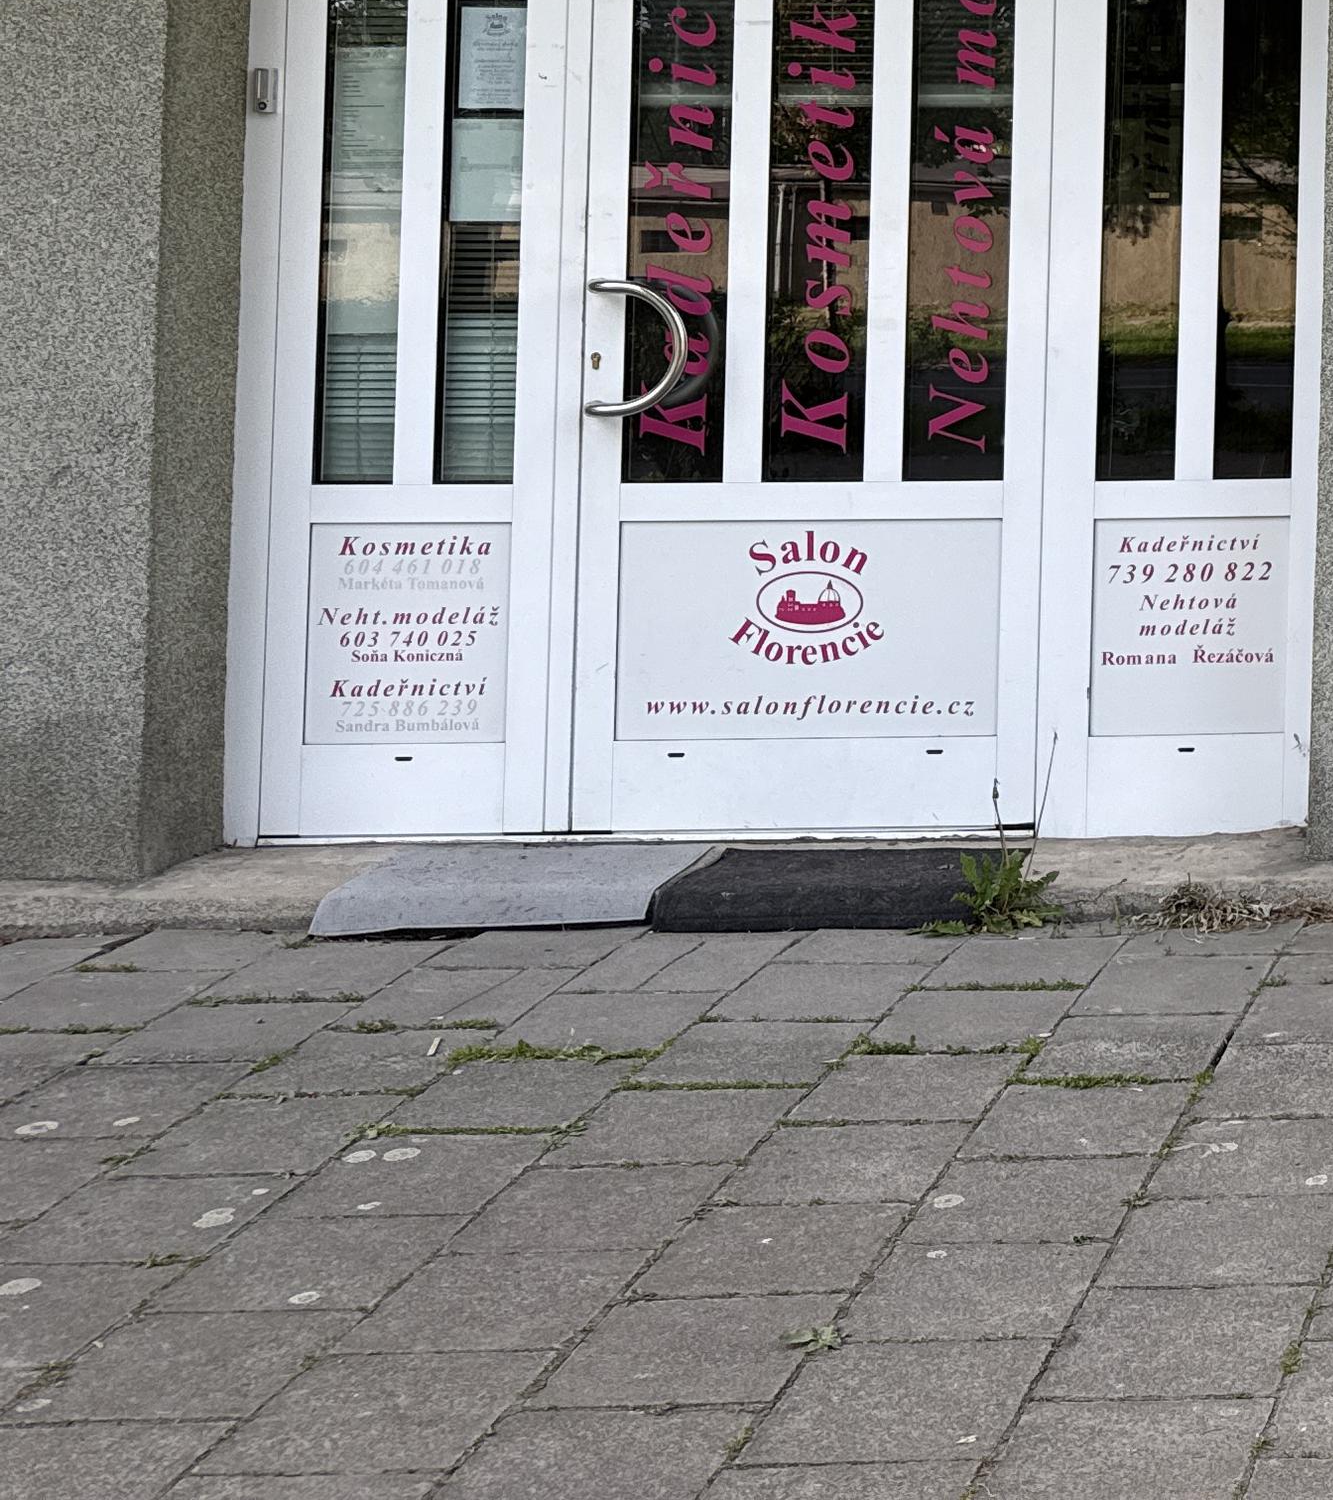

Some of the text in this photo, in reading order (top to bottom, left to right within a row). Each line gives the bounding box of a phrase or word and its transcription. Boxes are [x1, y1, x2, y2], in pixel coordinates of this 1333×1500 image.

[928, 126, 995, 451] Nehtová
[338, 535, 492, 557] Kosmetika
[749, 530, 868, 576] Salon
[1118, 533, 1261, 554] Kadeřnictví
[344, 558, 384, 576] 604
[441, 558, 482, 575] 018
[1107, 560, 1274, 585] 739 280 822
[1138, 592, 1238, 612] Nehtová
[1138, 617, 1238, 637] modeláž
[339, 630, 478, 648] 603 740 025
[728, 617, 885, 665] Florencie
[351, 649, 464, 663] Soňa Koniczná
[1100, 644, 1275, 667] Romana Řezáčová
[329, 676, 488, 698] Kadeřnictví
[437, 699, 478, 717] 239
[646, 695, 976, 721] www.salonflorencie.cz
[334, 719, 390, 733] Sandra
